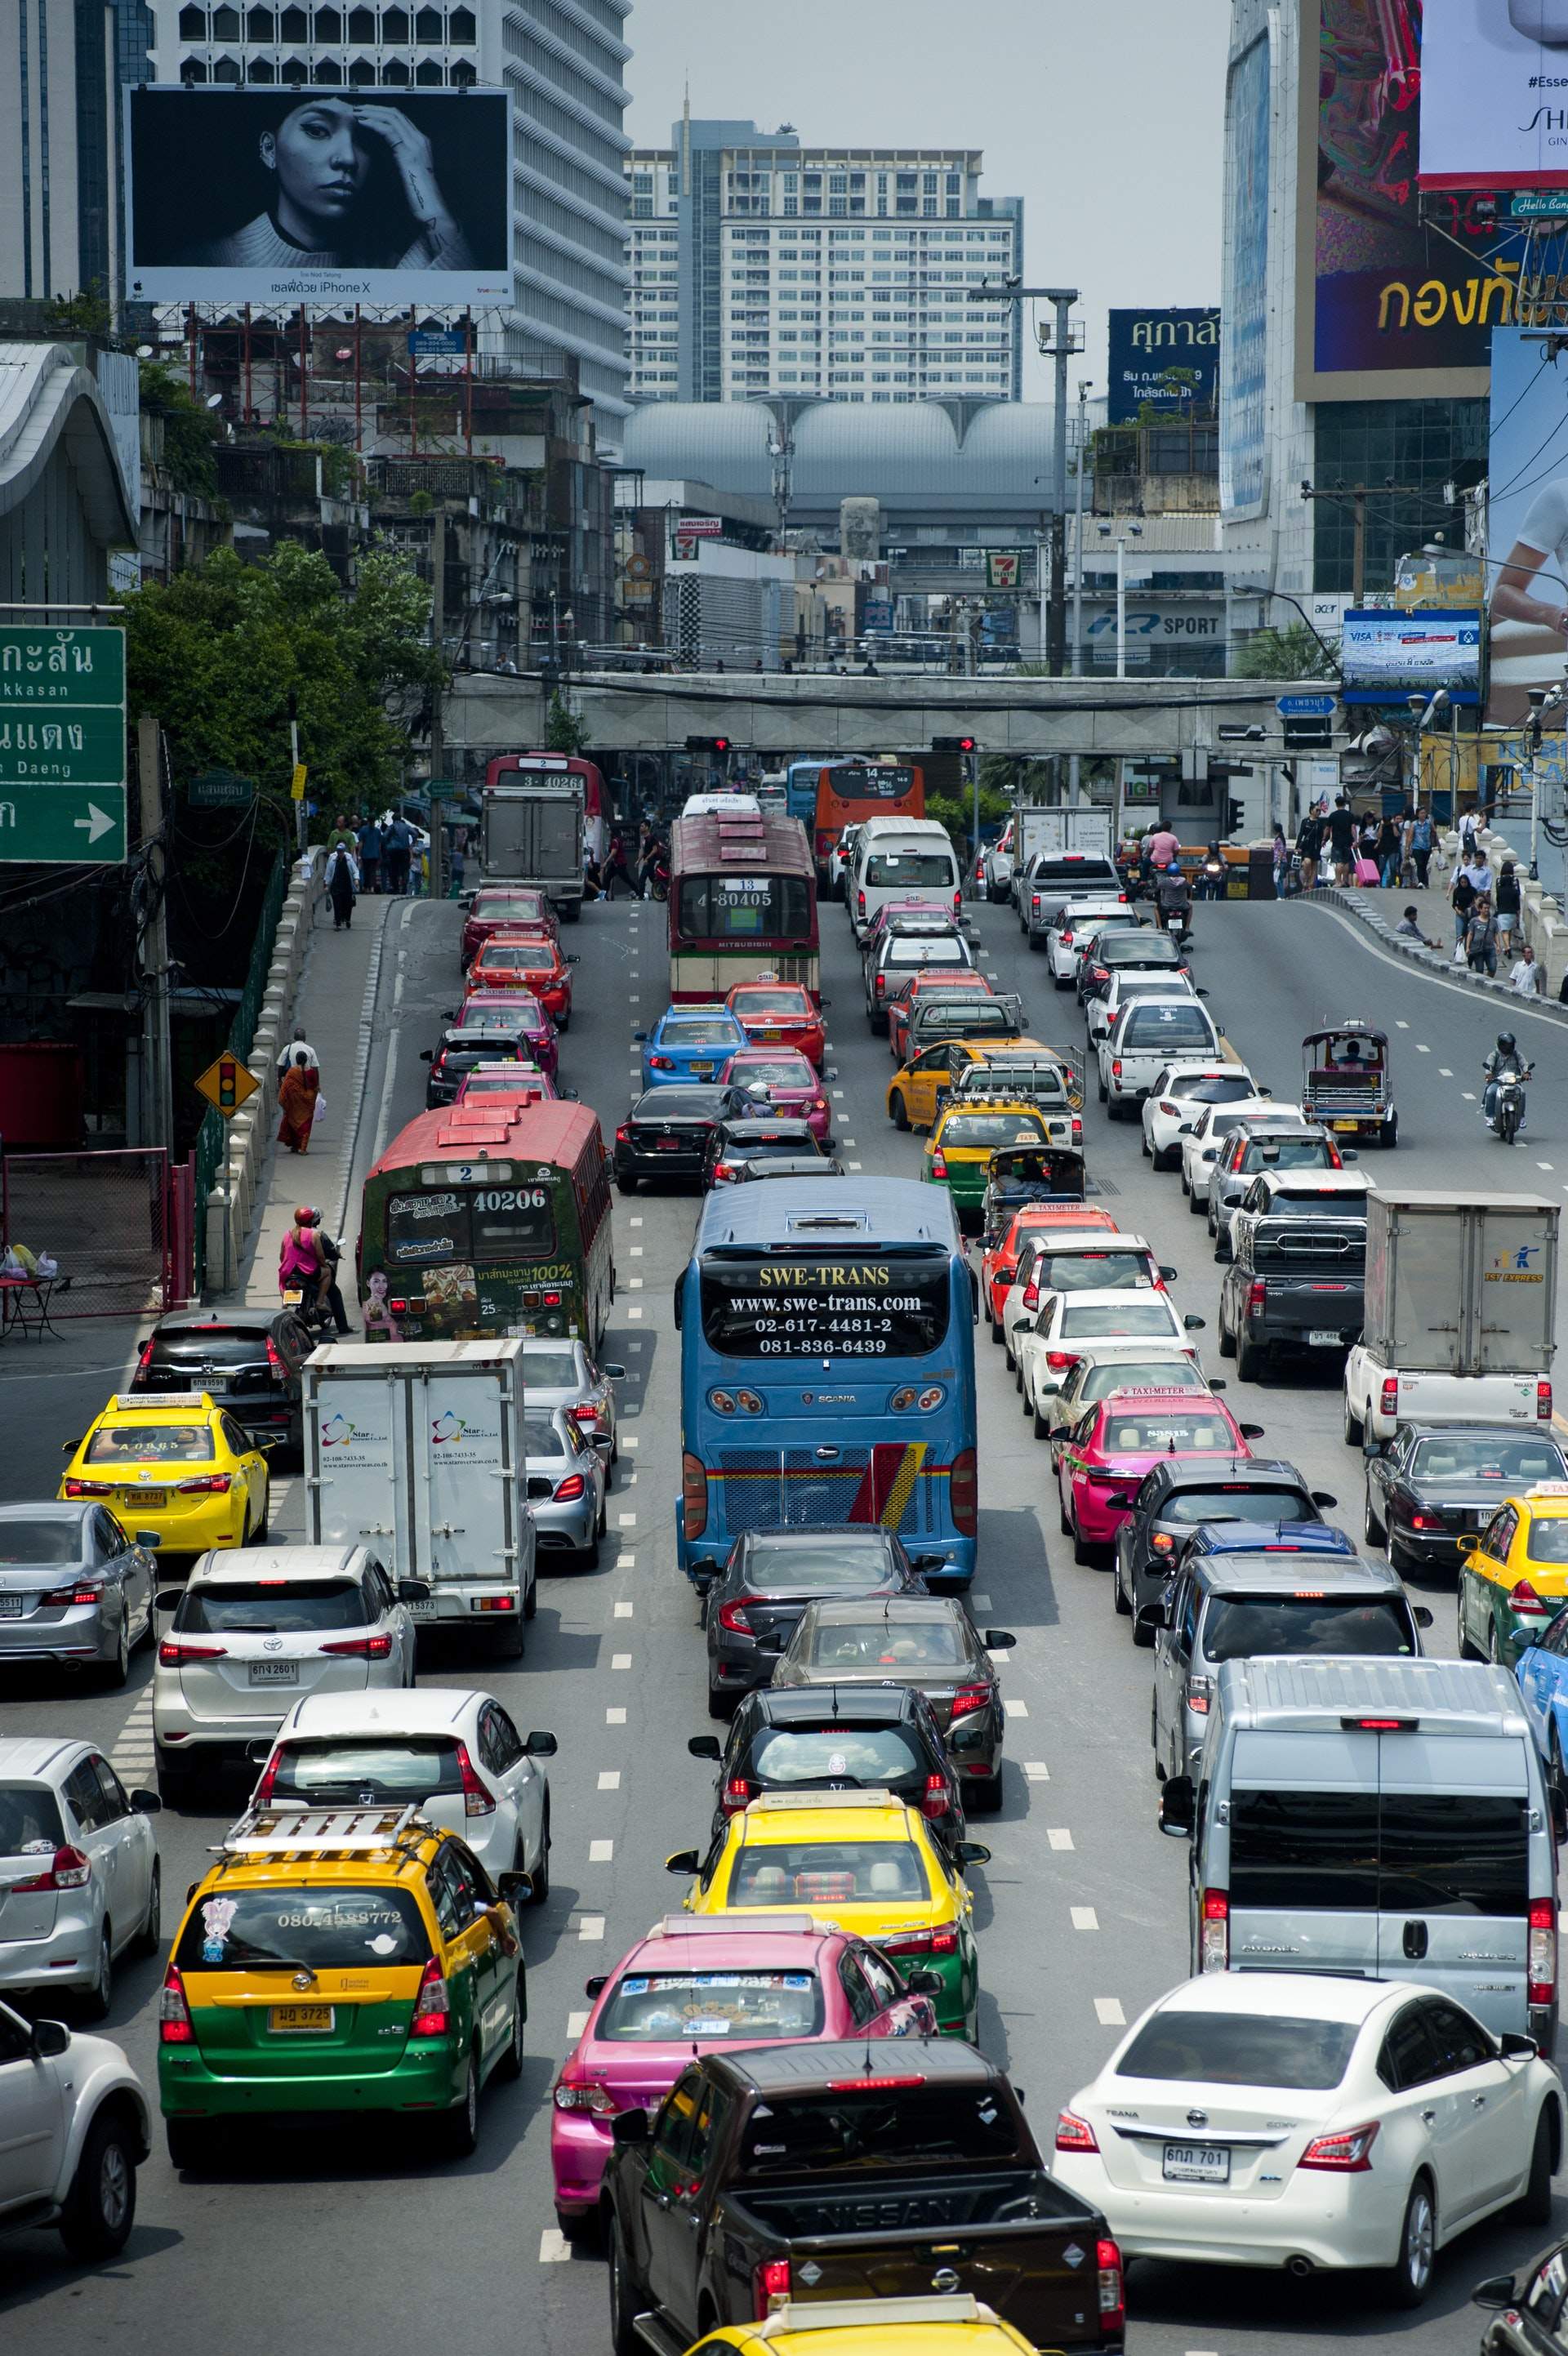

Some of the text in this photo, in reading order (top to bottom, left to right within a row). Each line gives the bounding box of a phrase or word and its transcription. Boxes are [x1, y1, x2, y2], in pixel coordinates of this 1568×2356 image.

[1518, 198, 1546, 212] Hello
[320, 281, 360, 293] iPhone
[362, 282, 371, 293] X
[1195, 369, 1202, 380] 9
[1164, 617, 1219, 635] SPORT
[1351, 632, 1372, 641] VISA
[17, 760, 71, 777] Daeng
[540, 759, 547, 768] 2
[865, 768, 879, 778] 14
[739, 880, 755, 890] 13
[460, 1166, 472, 1182] 2
[474, 1189, 546, 1212] 40206
[531, 1263, 572, 1282] 100%
[759, 1266, 890, 1287] SWE-TRANS
[1503, 1273, 1544, 1284] EXPRESS
[754, 1318, 893, 1333] 02-617-4481-2
[759, 1339, 887, 1353] 081-836-6439
[1132, 1387, 1185, 1395] TAXI-METER
[817, 1394, 857, 1404] SCANIA
[0, 1598, 20, 1607] 5511
[273, 1664, 295, 1675] 2601
[301, 2008, 330, 2021] 3725
[1105, 2109, 1140, 2118] TEANA
[1200, 2151, 1223, 2165] 701
[817, 2199, 953, 2228] NISSAN
